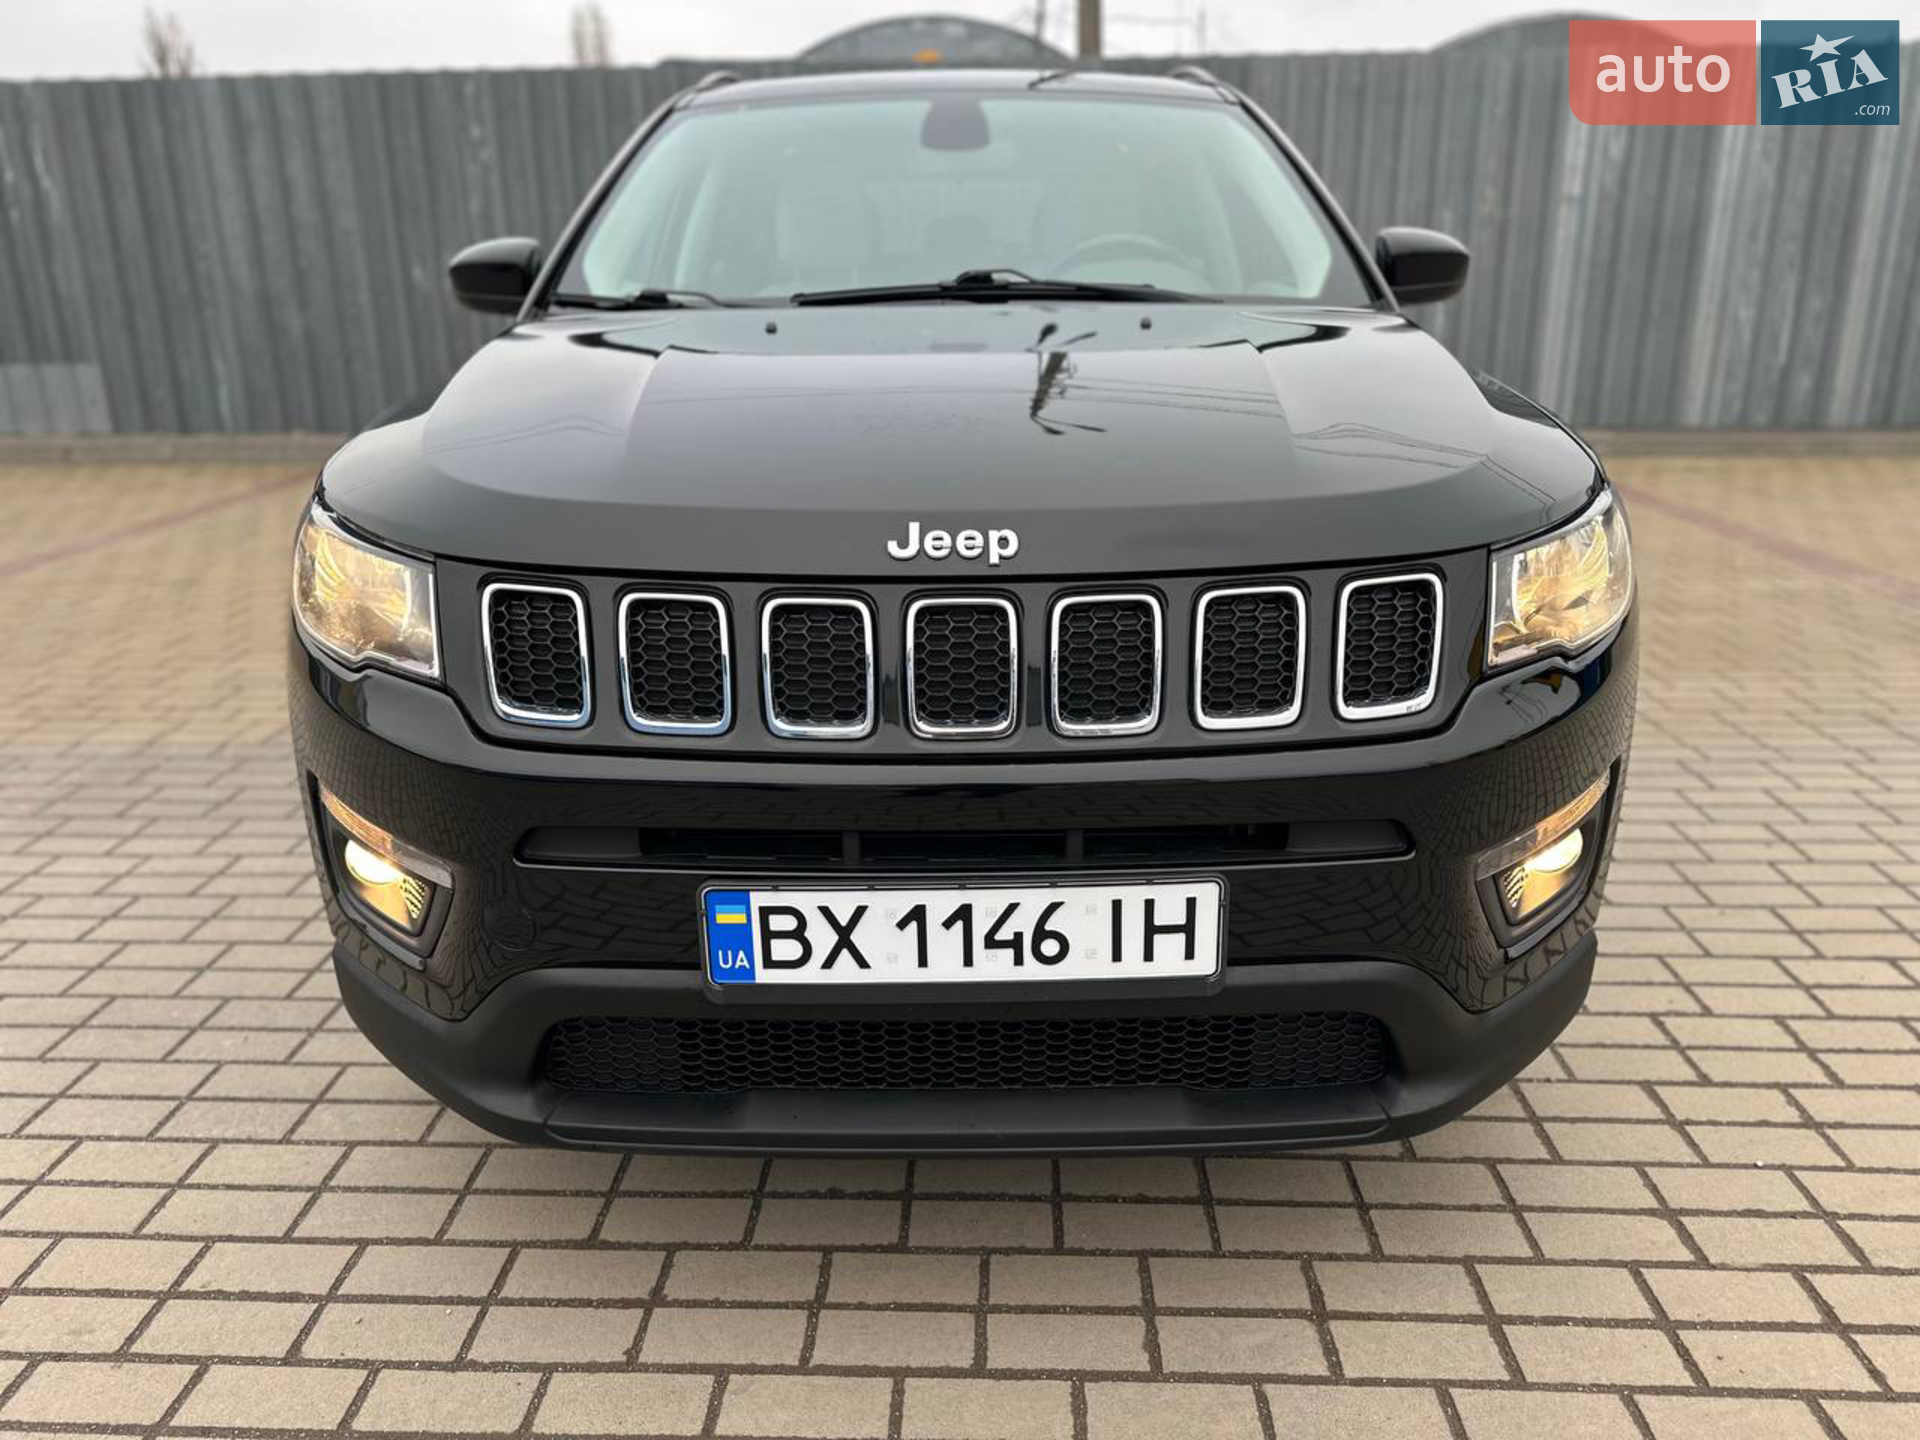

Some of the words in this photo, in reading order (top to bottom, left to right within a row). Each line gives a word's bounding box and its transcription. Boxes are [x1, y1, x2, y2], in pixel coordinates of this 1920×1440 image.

[887, 521, 1019, 566] Jeep
[758, 904, 872, 969] BX
[895, 901, 1070, 968] 1146
[1111, 896, 1197, 963] IH
[718, 949, 750, 969] UA
